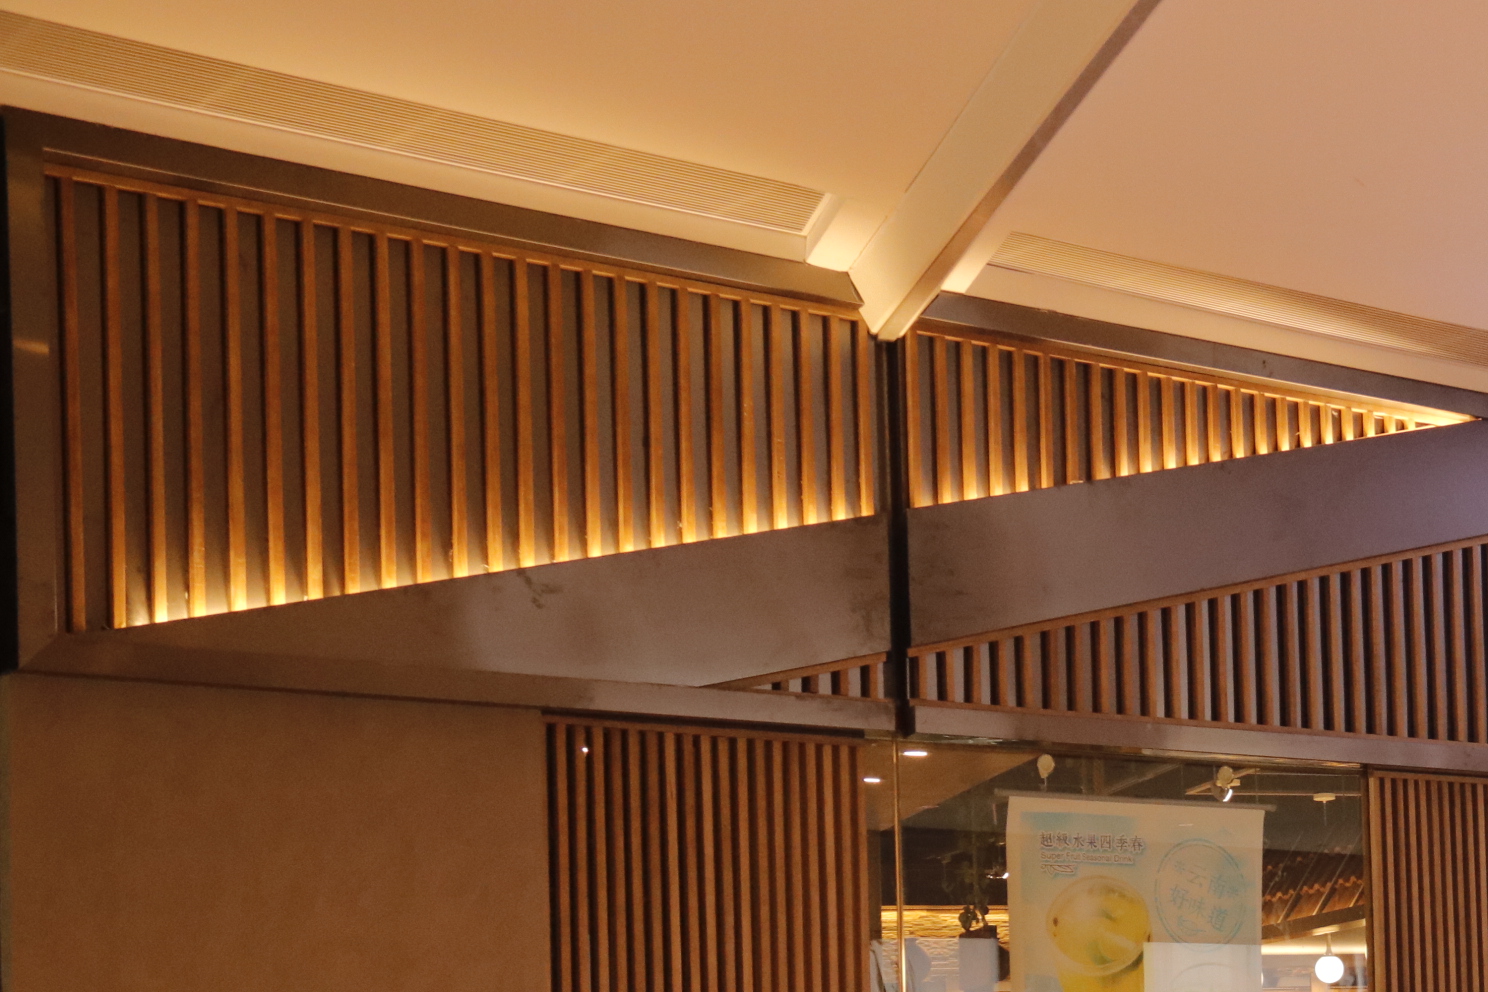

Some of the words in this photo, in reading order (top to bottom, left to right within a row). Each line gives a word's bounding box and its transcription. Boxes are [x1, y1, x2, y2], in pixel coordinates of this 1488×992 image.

[1040, 852, 1064, 861] Super
[1066, 852, 1082, 860] Fruit
[1082, 853, 1112, 862] Seasonal
[1114, 855, 1133, 863] Drink
